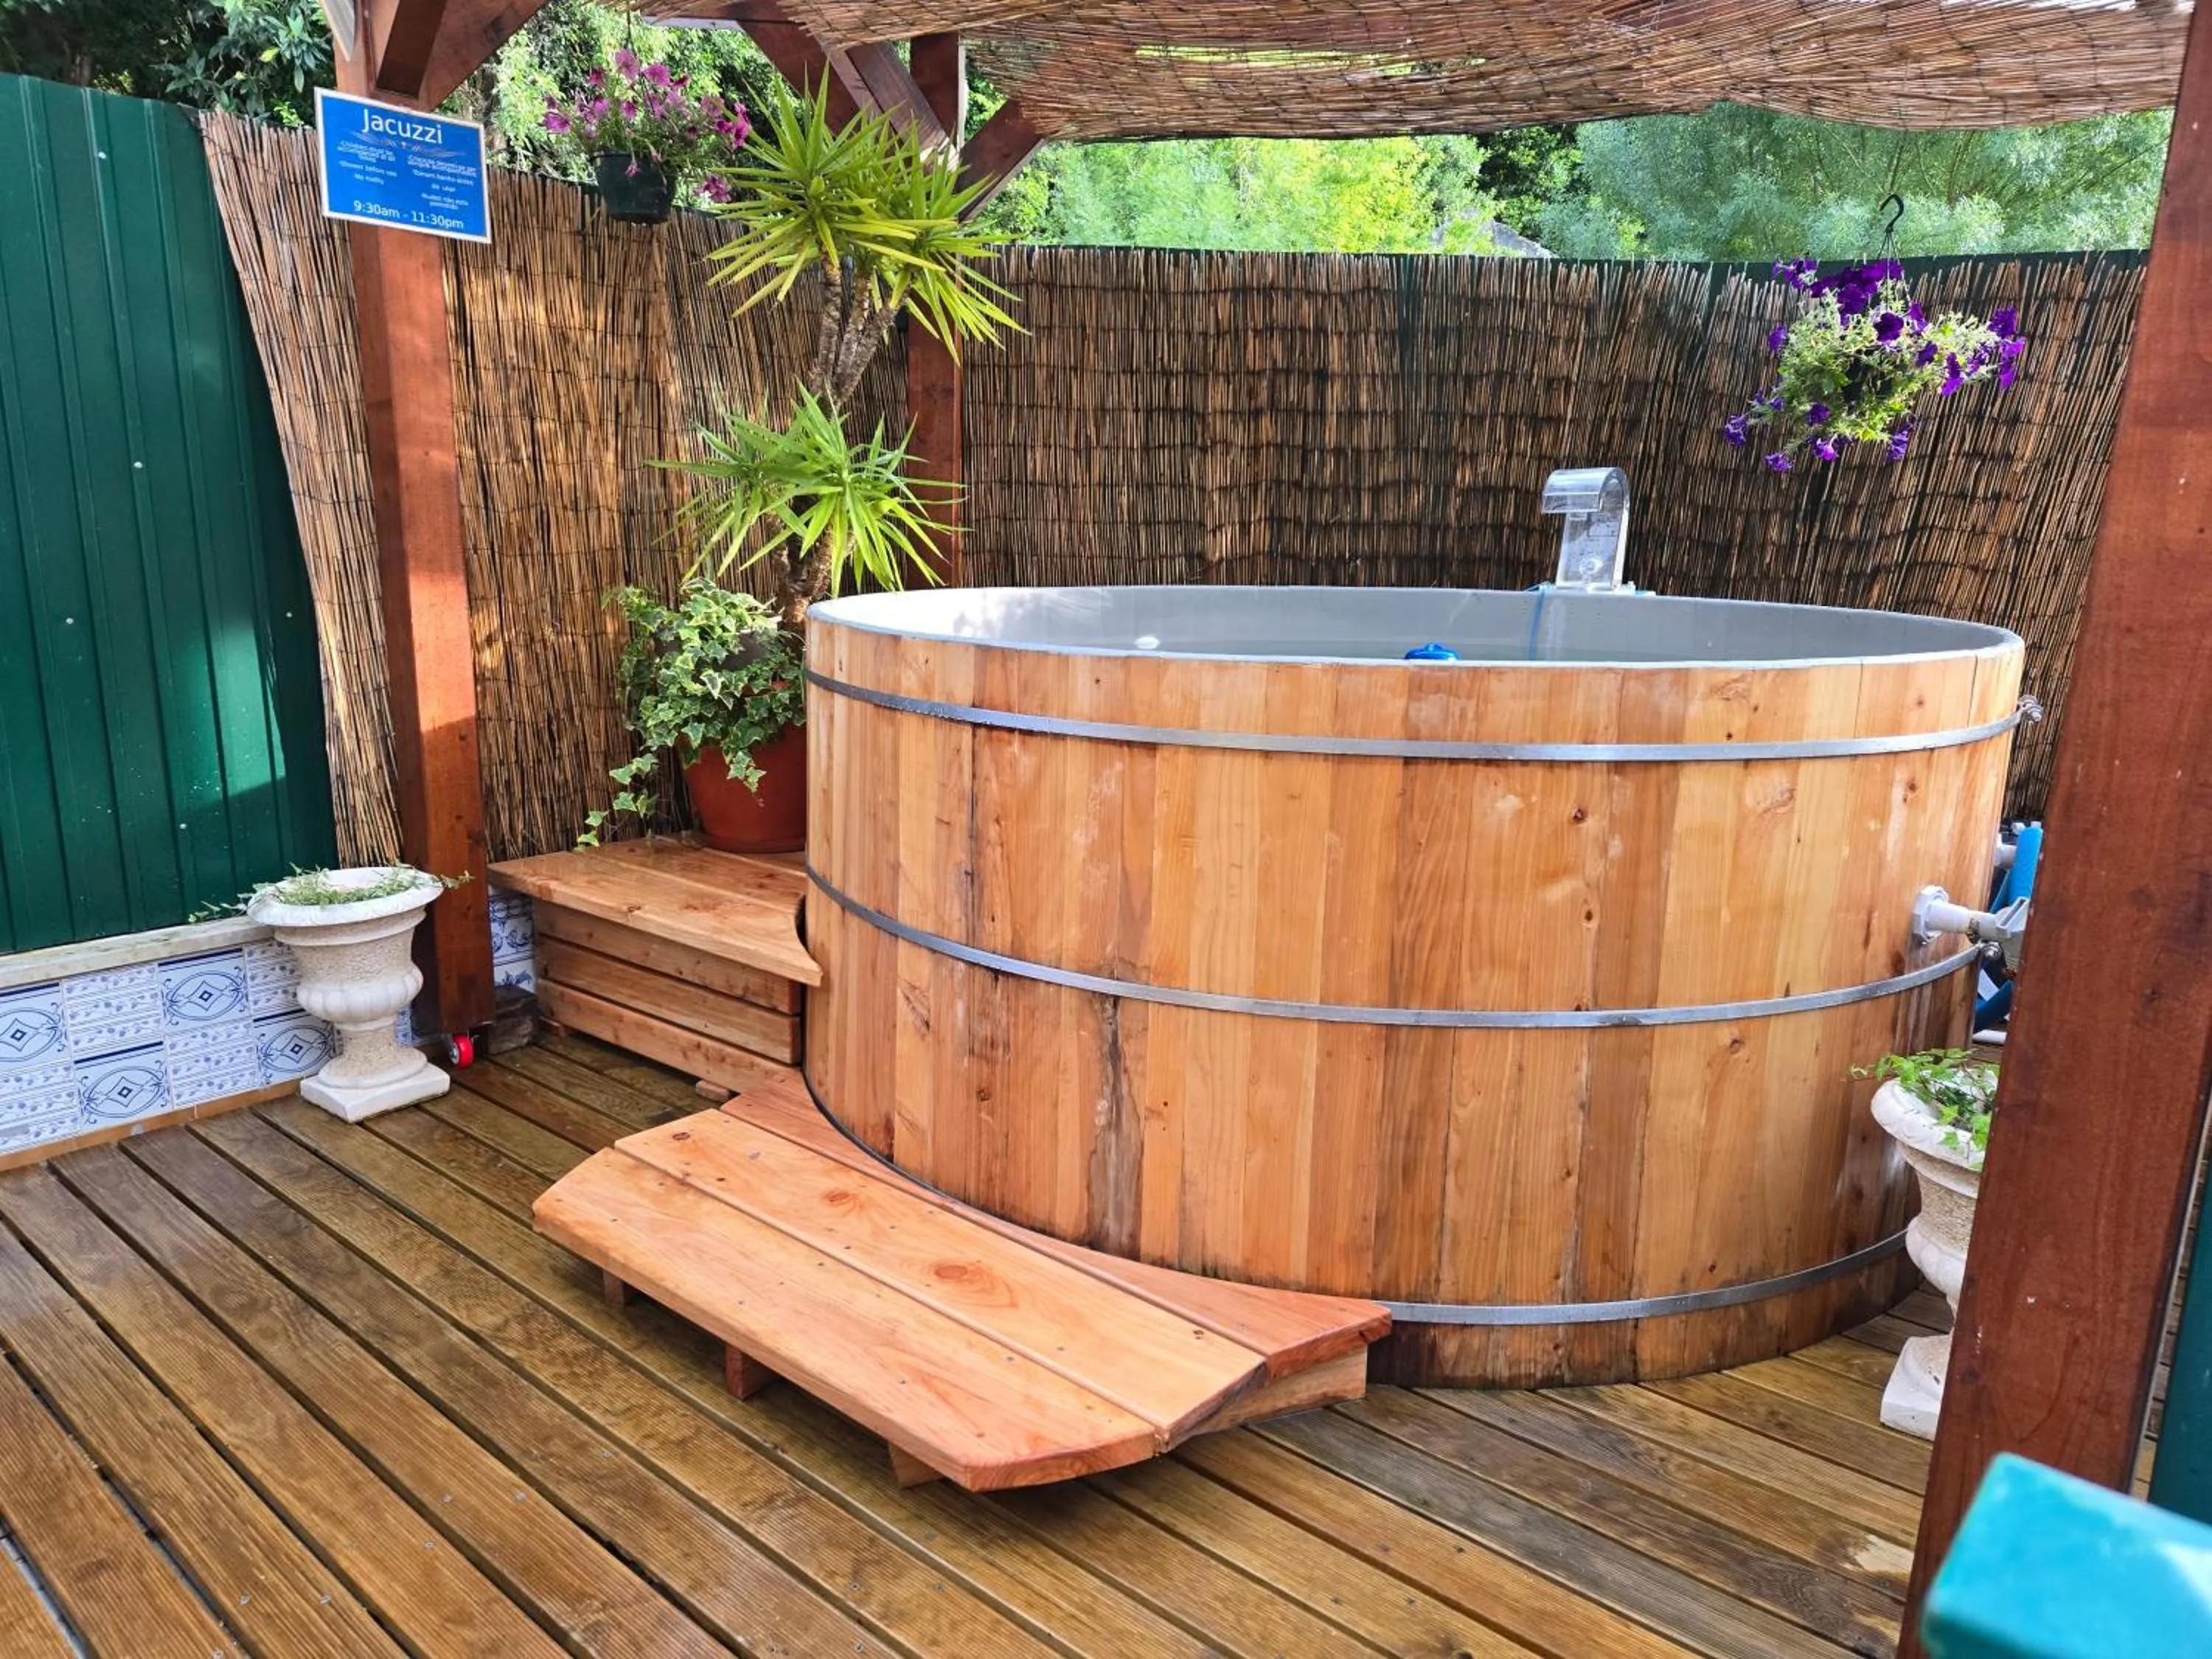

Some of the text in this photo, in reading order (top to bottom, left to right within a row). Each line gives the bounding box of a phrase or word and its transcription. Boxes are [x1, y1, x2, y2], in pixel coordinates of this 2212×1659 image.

[362, 108, 442, 144] Jacuzzi
[353, 200, 400, 219] 9:30am
[411, 210, 465, 229] 11:30pm
